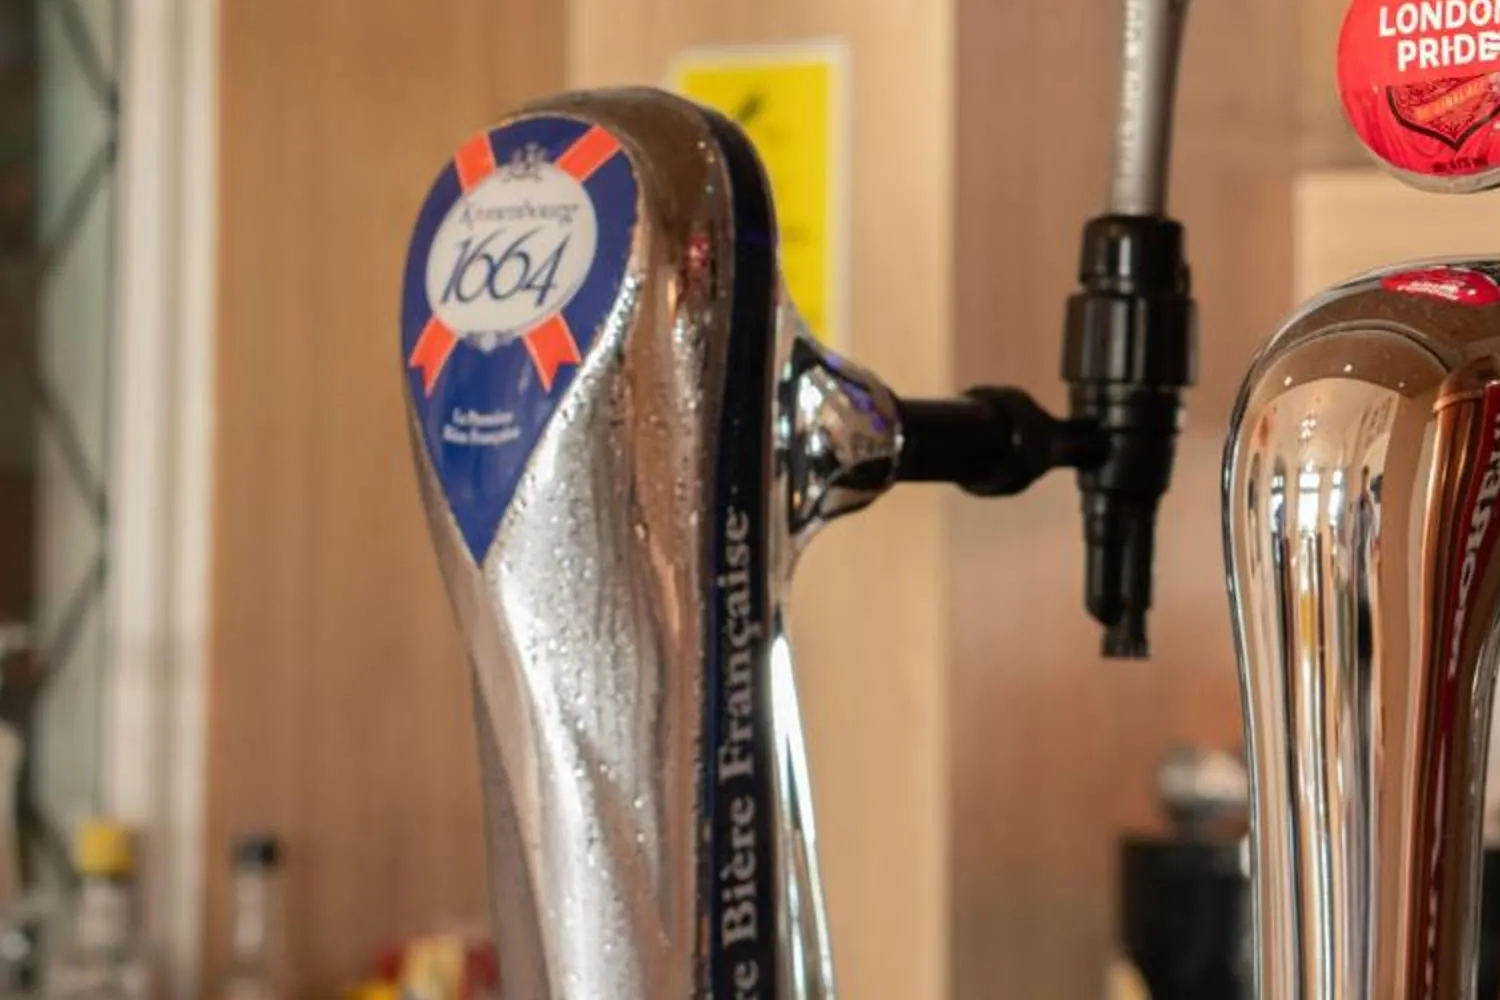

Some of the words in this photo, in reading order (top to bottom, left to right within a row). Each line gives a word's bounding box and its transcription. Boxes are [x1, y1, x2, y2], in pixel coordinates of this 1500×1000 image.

[1396, 30, 1500, 73] PRIDE
[440, 226, 571, 307] 1664
[717, 508, 763, 785] Française
[719, 795, 757, 948] Bière
